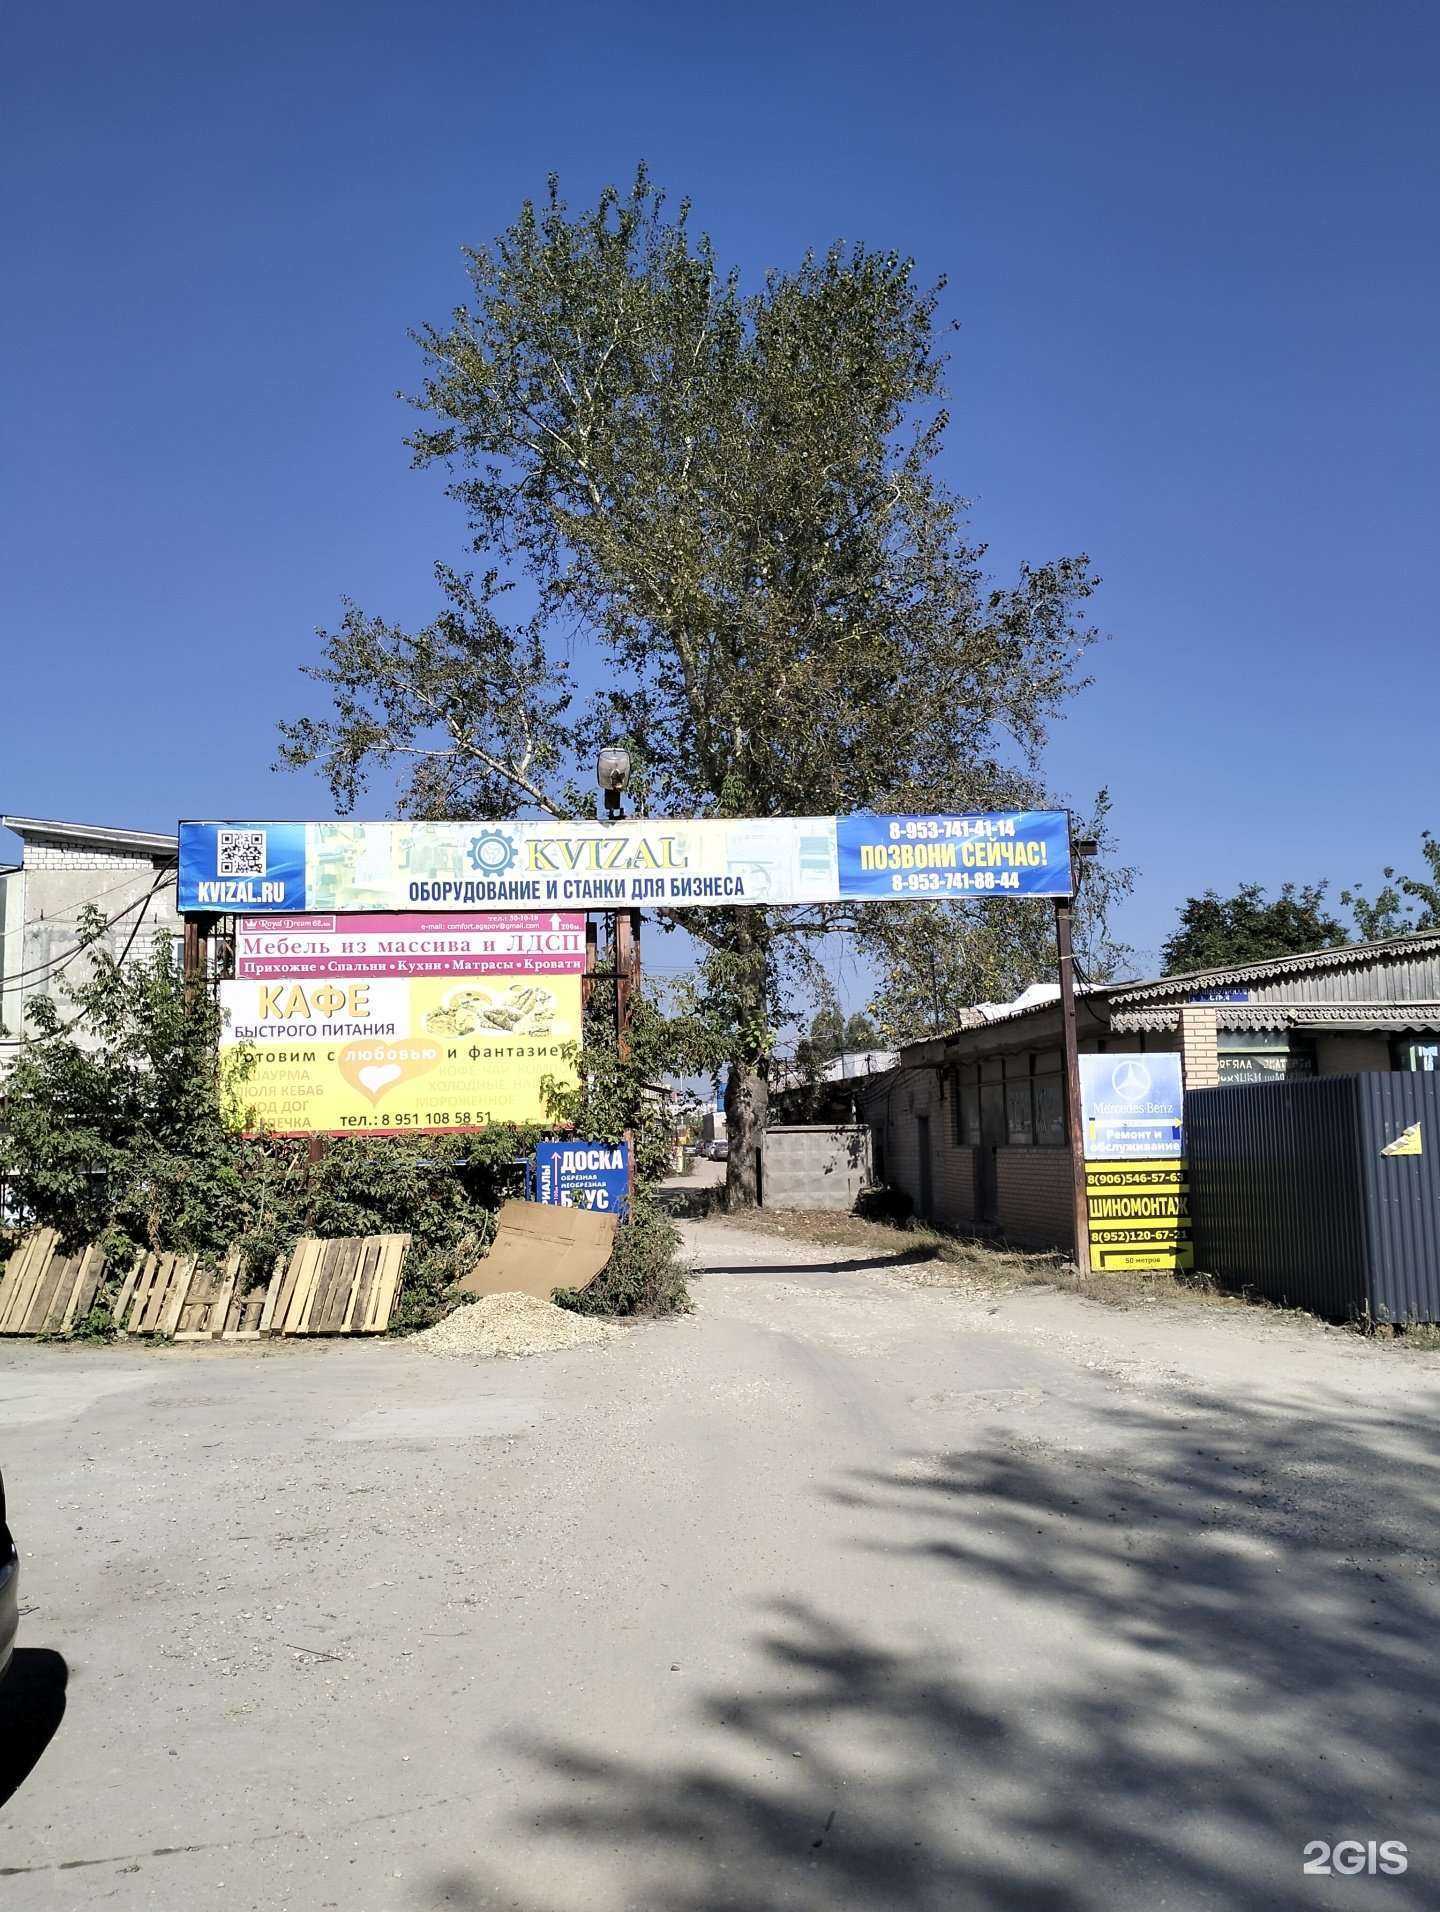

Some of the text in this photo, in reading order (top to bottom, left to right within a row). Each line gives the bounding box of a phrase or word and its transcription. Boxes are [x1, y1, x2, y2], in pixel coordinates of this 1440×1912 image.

[889, 819, 1016, 840] 8-953-741-41-14
[525, 836, 689, 871] KVIZAL
[860, 835, 1048, 871] ПОЗВОНИ СЕЙЧАС!
[409, 875, 745, 903] ОБОРУДОВАНИЕ И СТАНКИ ДЛЯ БИЗНЕСА
[891, 871, 1020, 891] 8-953-741-88-44
[198, 881, 285, 903] KVIZAL.RU
[243, 934, 580, 955] Мебель из массива и ЛДСП
[244, 958, 581, 975] Прихожие Спальни Кухни Матрасы Кровати
[258, 984, 370, 1019] КАФЕ
[235, 1023, 395, 1038] БЫСТРОГО ПИТАНИЯ
[327, 1051, 336, 1061] с
[345, 1046, 437, 1061] любовью
[447, 1049, 457, 1059] и
[281, 1084, 324, 1097] КЕБАБ
[340, 1111, 492, 1126] тел.: 8 951 108 58 51
[1106, 1128, 1162, 1139] Ремонт и
[561, 1150, 624, 1173] ДОСКА
[1087, 1173, 1184, 1186] 8(906)546-57-63
[561, 1189, 609, 1209] БУС
[1089, 1197, 1188, 1217] ШИНОМОНТАЖ
